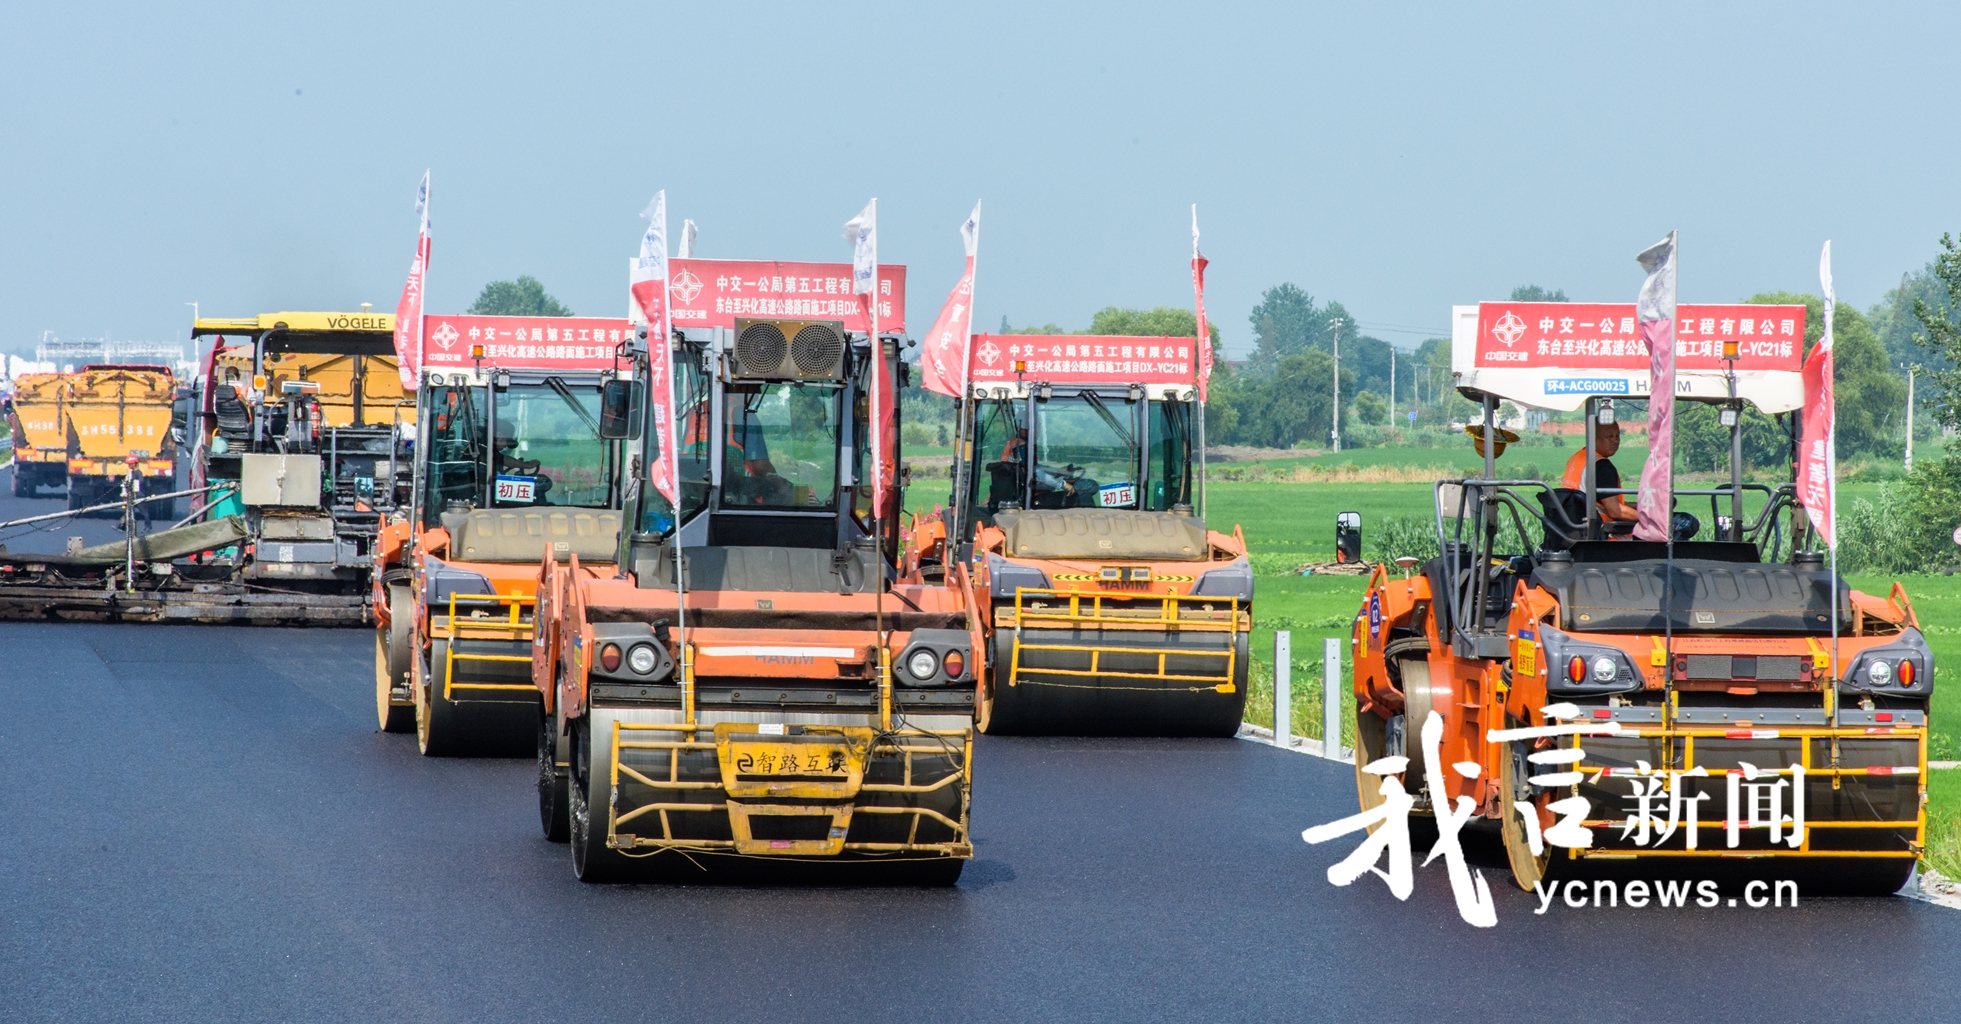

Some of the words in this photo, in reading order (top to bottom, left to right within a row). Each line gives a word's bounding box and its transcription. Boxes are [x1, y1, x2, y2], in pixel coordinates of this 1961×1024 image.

[716, 275, 892, 296] 中交一公局第五工程有司
[716, 298, 892, 318] 东台至兴化高速公路路面施工项目DX-1标
[327, 314, 387, 329] VÖGELE
[1539, 316, 1795, 336] 中交一公局工程有限公司
[428, 353, 462, 362] 中国交建
[1009, 343, 1189, 359] 中交一公局第五工程有限公司
[1485, 351, 1529, 362] 中国交建
[973, 369, 1004, 377] 中国交建
[1009, 360, 1189, 375] 东至兴化高速公路路面施工项目DX-YC21标
[1547, 380, 1626, 393] 环4-ACG00025
[1636, 380, 1692, 392] HM
[498, 483, 531, 499] 初压
[1103, 489, 1133, 505] 初压
[1099, 579, 1150, 591] HAMM
[756, 751, 849, 775] 智路互联
